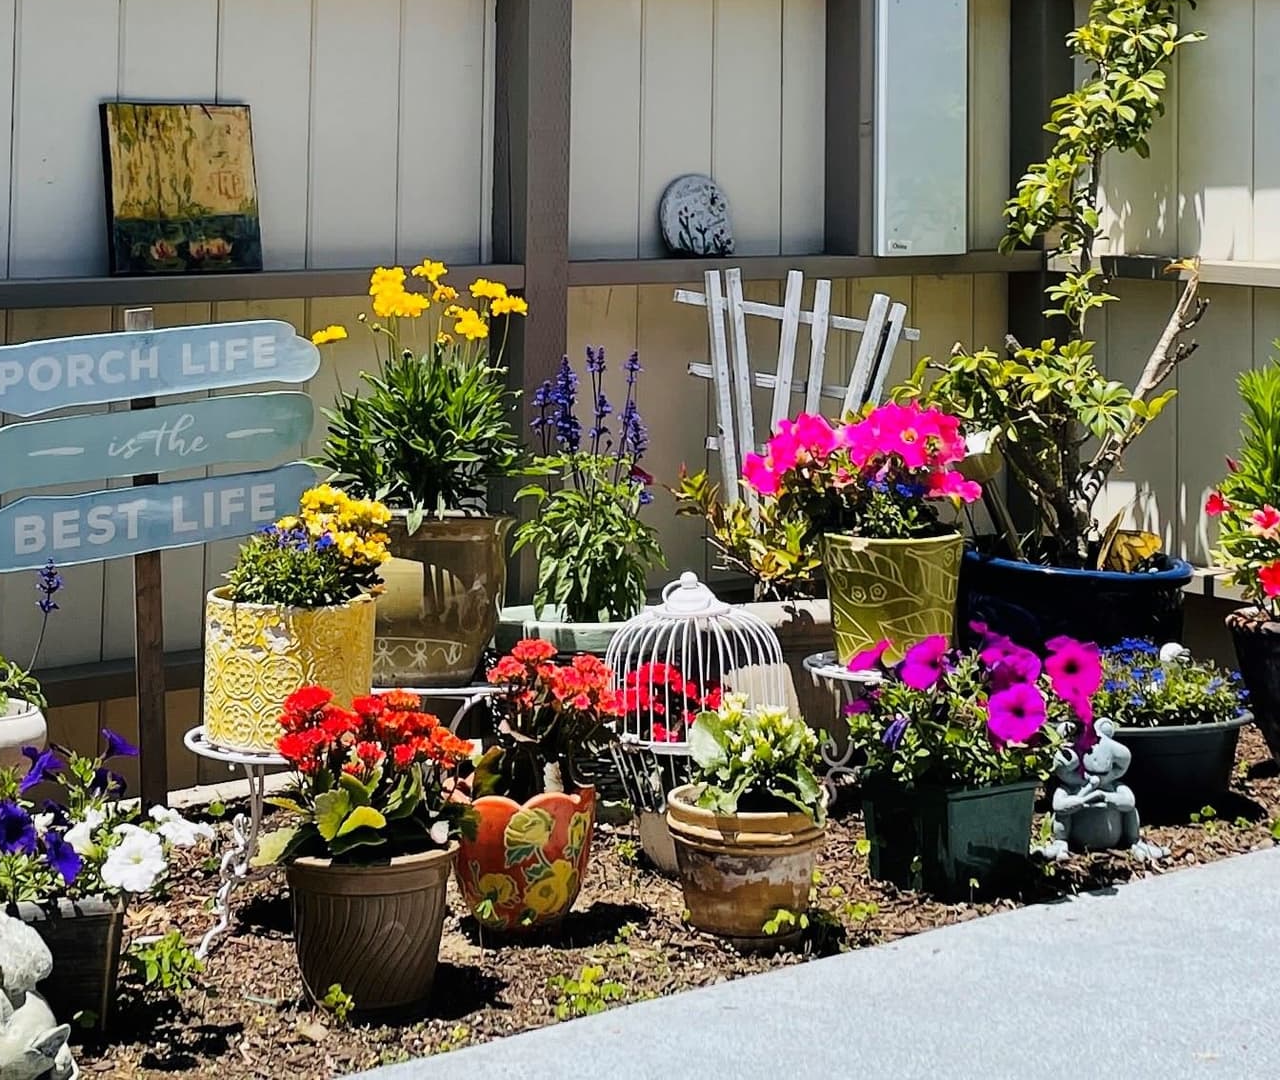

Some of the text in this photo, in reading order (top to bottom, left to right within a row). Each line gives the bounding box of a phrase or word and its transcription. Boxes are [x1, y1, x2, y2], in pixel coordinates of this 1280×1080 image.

[181, 335, 277, 376] LIFE
[107, 413, 208, 459] is the
[13, 483, 277, 555] BEST LIFE
